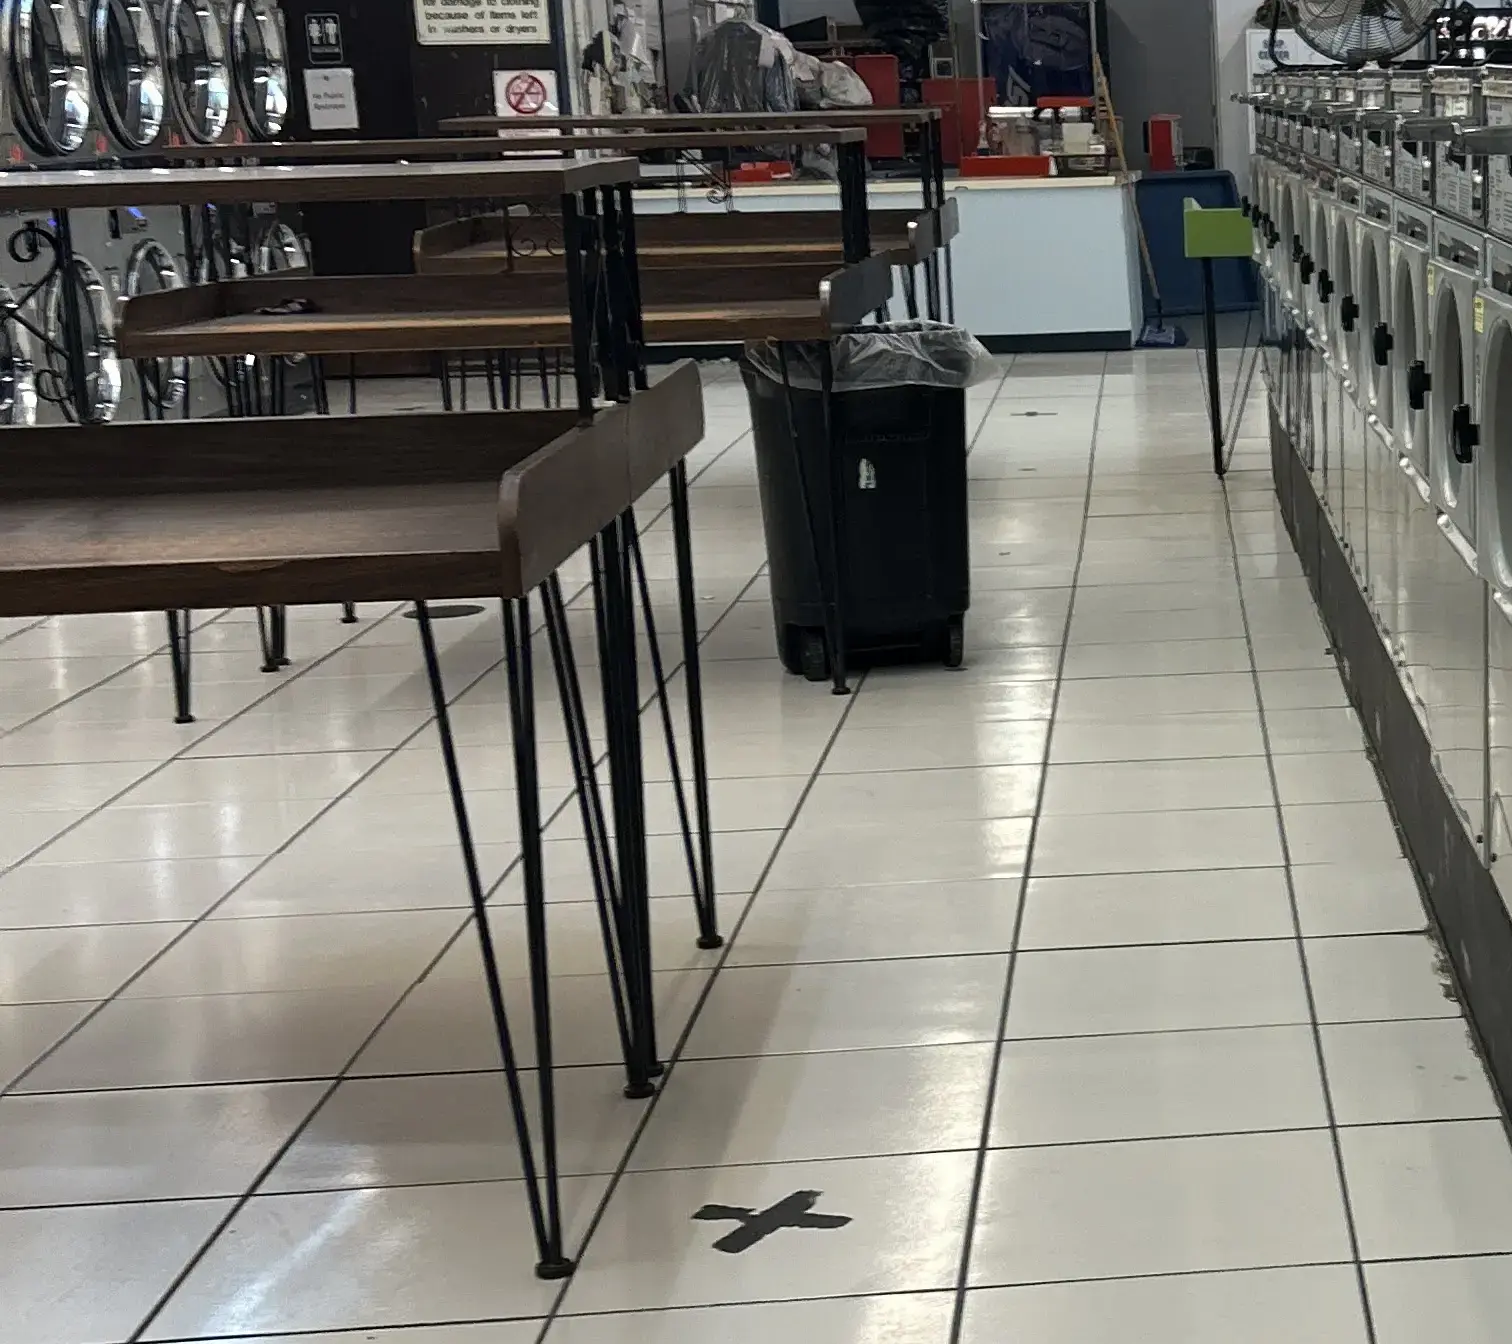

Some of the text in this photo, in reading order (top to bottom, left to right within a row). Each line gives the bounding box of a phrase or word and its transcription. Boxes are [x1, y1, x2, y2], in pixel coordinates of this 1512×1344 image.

[425, 10, 469, 20] because
[474, 10, 485, 20] of
[521, 10, 538, 19] left
[490, 25, 501, 33] or
[505, 24, 537, 35] dryers
